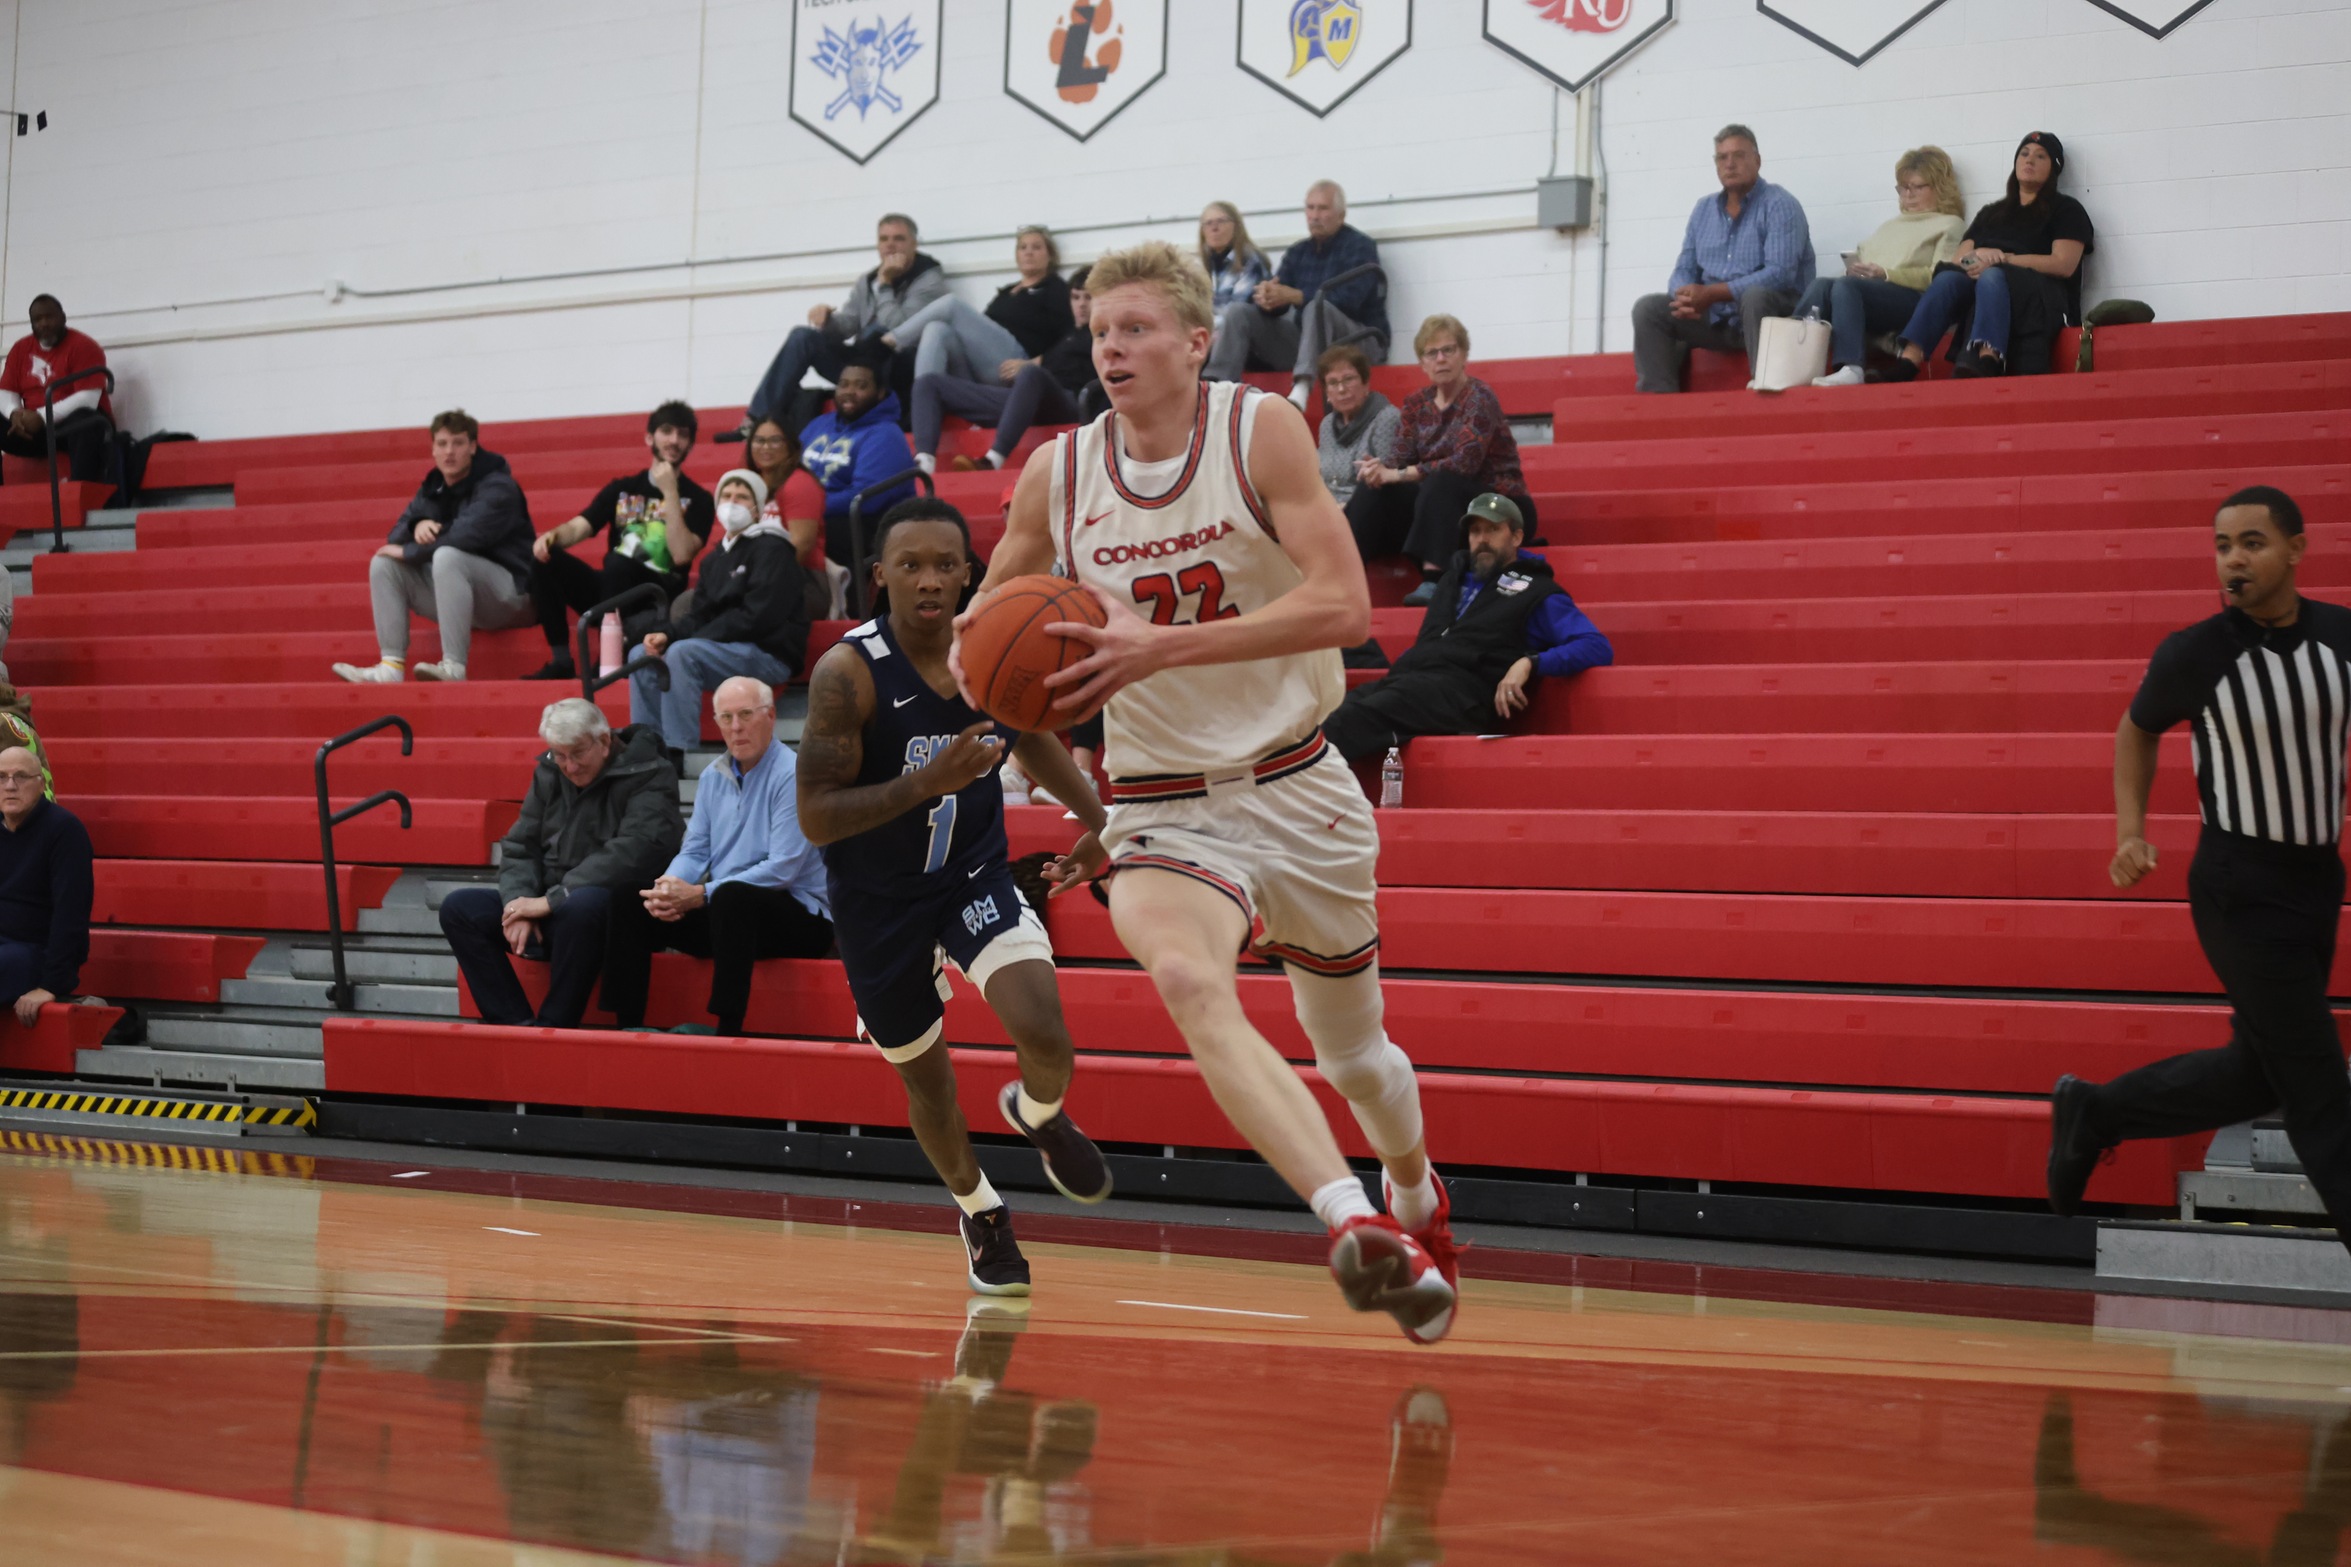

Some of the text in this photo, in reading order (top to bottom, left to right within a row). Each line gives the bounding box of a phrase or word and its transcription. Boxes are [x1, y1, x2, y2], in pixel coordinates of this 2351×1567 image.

[1055, 6, 1110, 88] L
[1328, 17, 1352, 41] M
[1093, 520, 1235, 566] CONCORDIA
[1131, 560, 1241, 625] 22
[923, 794, 957, 873] 1
